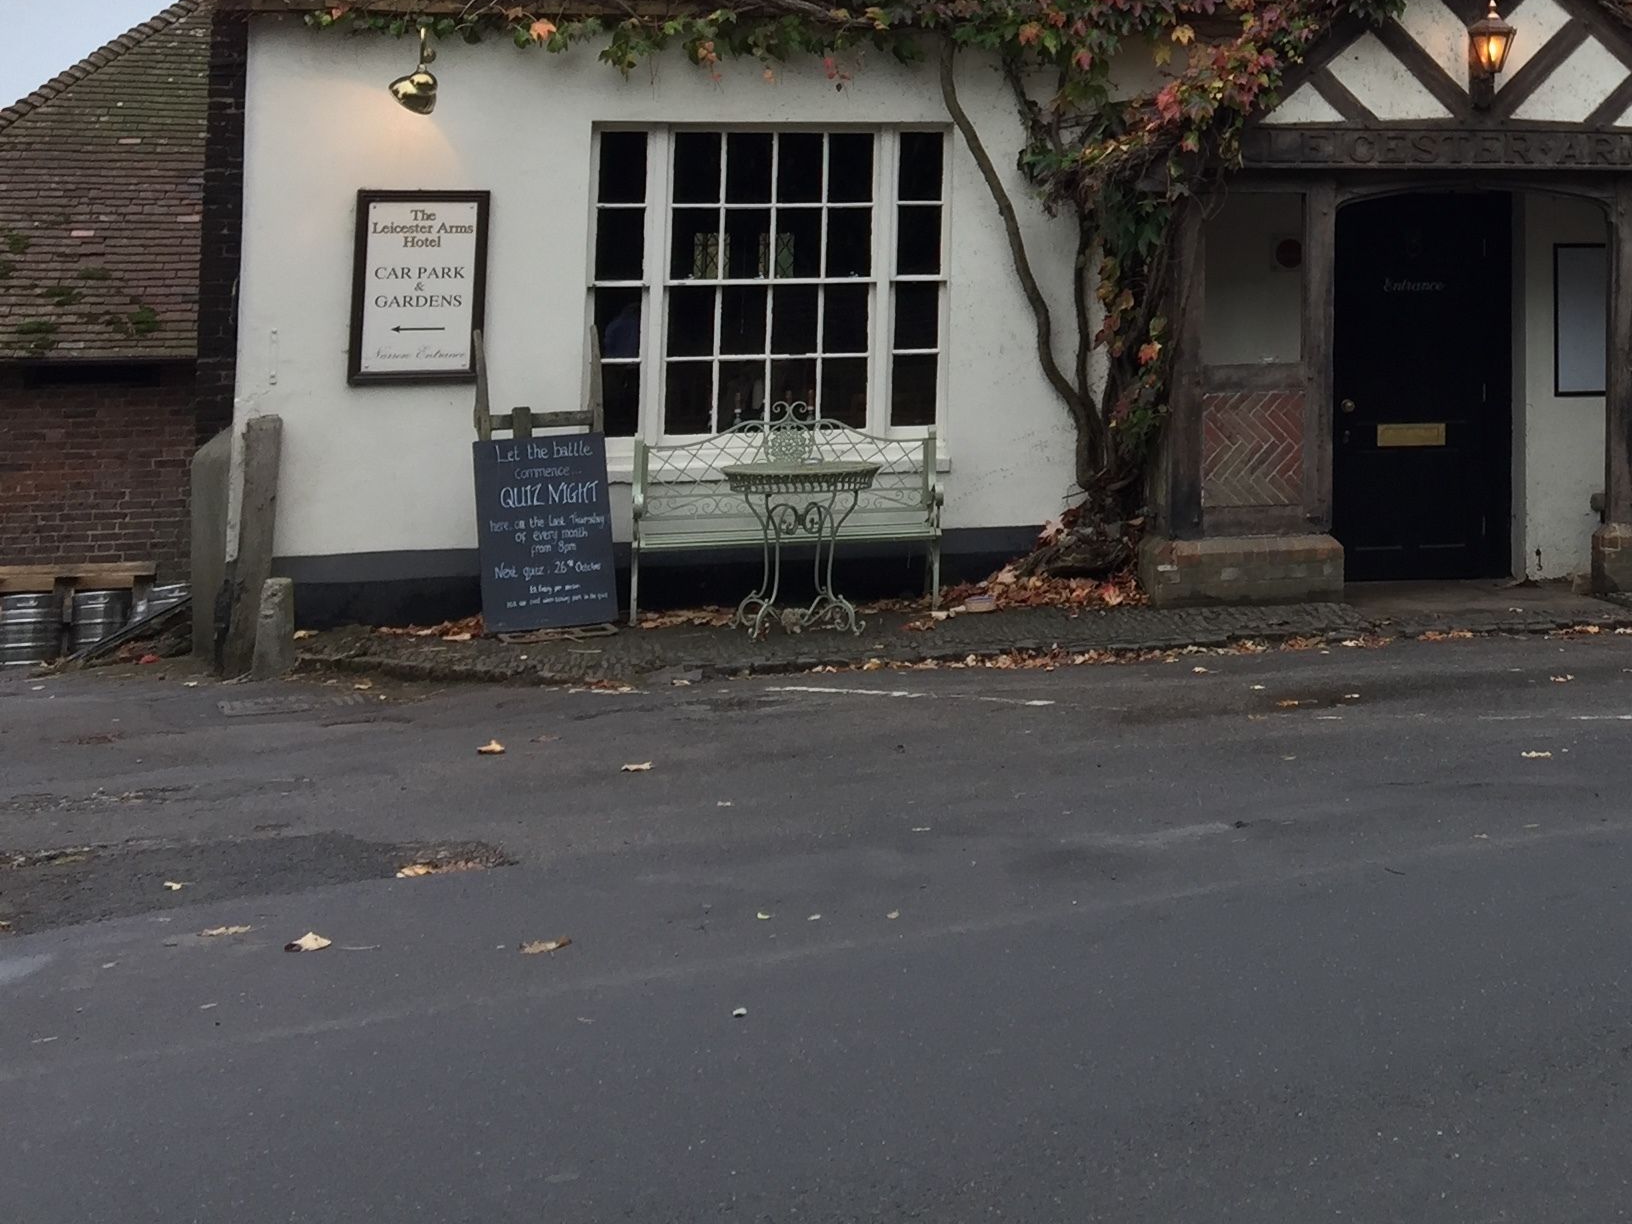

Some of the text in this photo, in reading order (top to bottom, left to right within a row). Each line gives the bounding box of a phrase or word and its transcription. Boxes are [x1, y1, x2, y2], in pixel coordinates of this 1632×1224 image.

[1263, 131, 1534, 164] LEICESTER
[410, 209, 437, 222] The
[372, 222, 474, 235] Leicester Arms
[402, 235, 442, 248] Hotel
[374, 266, 465, 280] CAR PARK
[413, 281, 425, 292] &
[1383, 277, 1445, 292] Entrance
[374, 294, 463, 309] GARDENS
[495, 440, 593, 463] Let the battle
[500, 480, 599, 508] QUIZ NIGHT
[529, 515, 545, 529] the
[514, 531, 527, 544] of
[532, 528, 558, 545] every
[530, 544, 552, 558] from
[494, 561, 519, 580] Next
